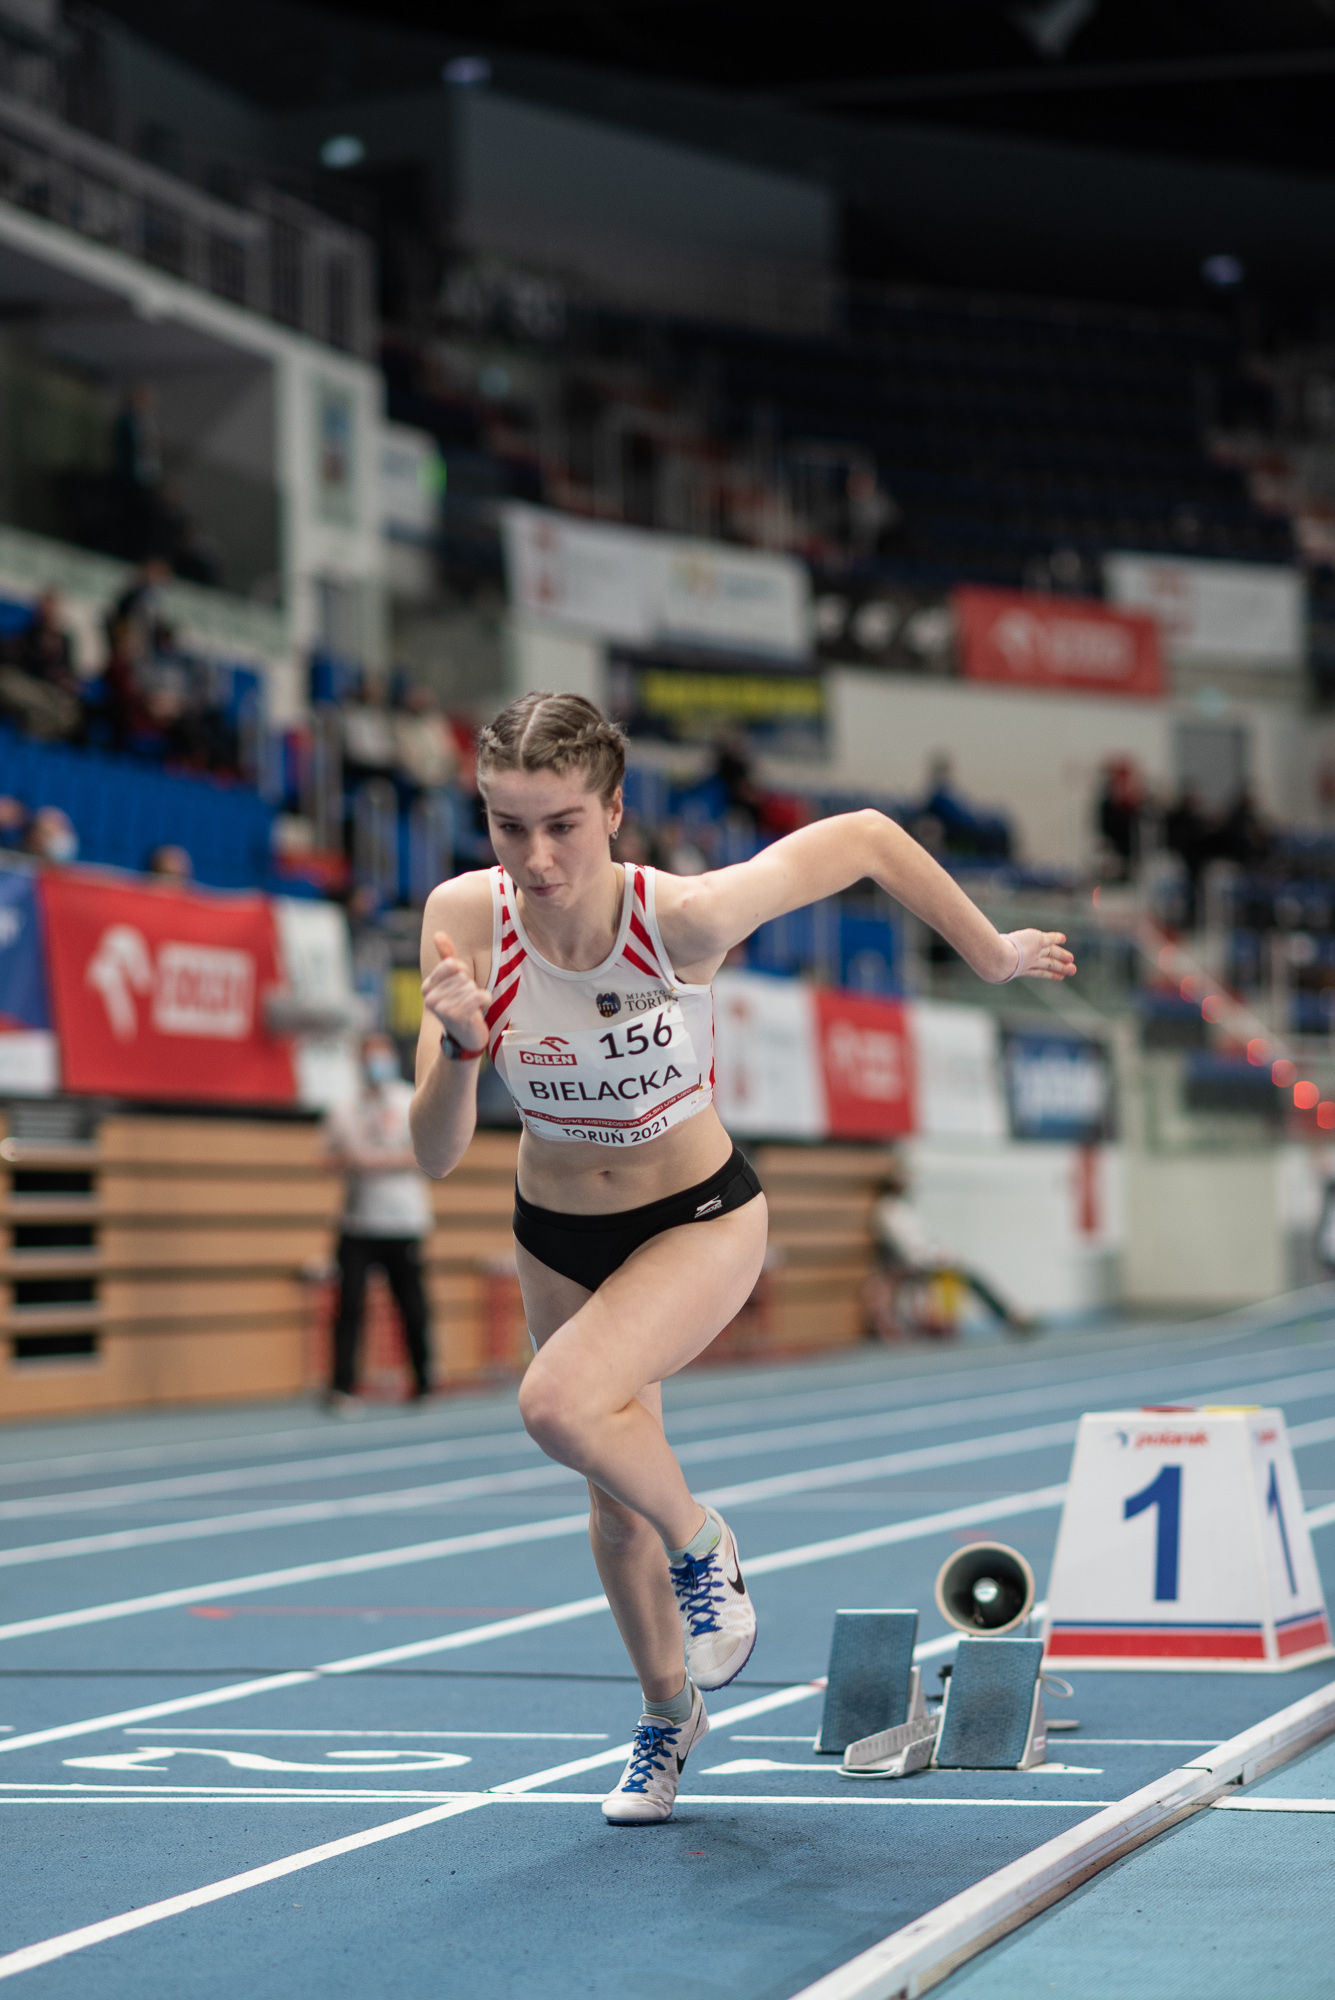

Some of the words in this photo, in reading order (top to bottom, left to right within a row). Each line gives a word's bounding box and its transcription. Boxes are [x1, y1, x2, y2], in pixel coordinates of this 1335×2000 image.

[626, 990, 666, 1000] MIASTO
[599, 1012, 672, 1059] 156
[522, 1052, 575, 1065] ORLEN
[529, 1064, 683, 1101] BIELACKA
[551, 1116, 583, 1124] HALOWE
[584, 1119, 640, 1127] MISTRZOSTWA
[640, 1104, 664, 1123] POLSKI
[562, 1128, 625, 1145] TORUŃ
[630, 1116, 669, 1143] 2021
[1124, 1465, 1182, 1601] 1
[1267, 1460, 1297, 1596] 1
